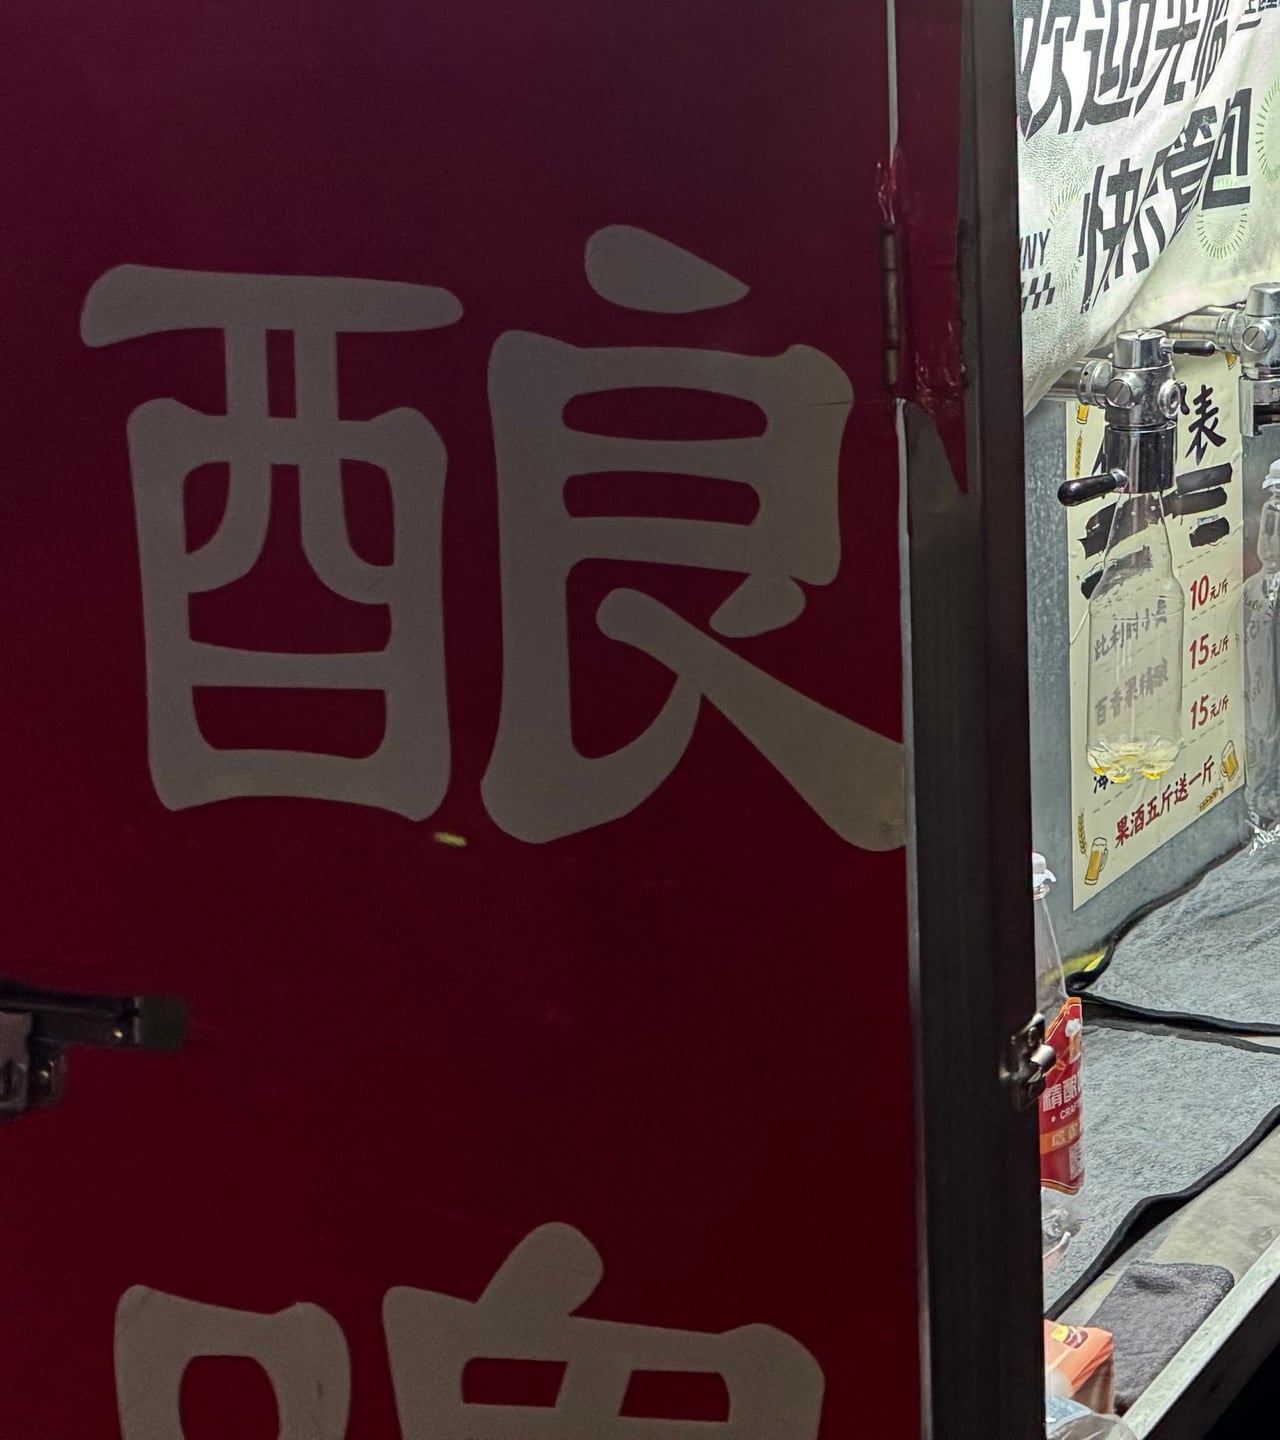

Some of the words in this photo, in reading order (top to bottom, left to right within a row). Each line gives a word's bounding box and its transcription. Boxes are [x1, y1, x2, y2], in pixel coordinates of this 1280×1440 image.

[1020, 228, 1051, 271] NY
[80, 224, 907, 852] 酿
[1189, 574, 1229, 611] 10元/斤
[1189, 633, 1230, 670] 15元/斤
[1190, 694, 1230, 730] 15元/斤
[1114, 755, 1215, 849] 果酒五斤送一斤
[1042, 1071, 1081, 1112] 精酿
